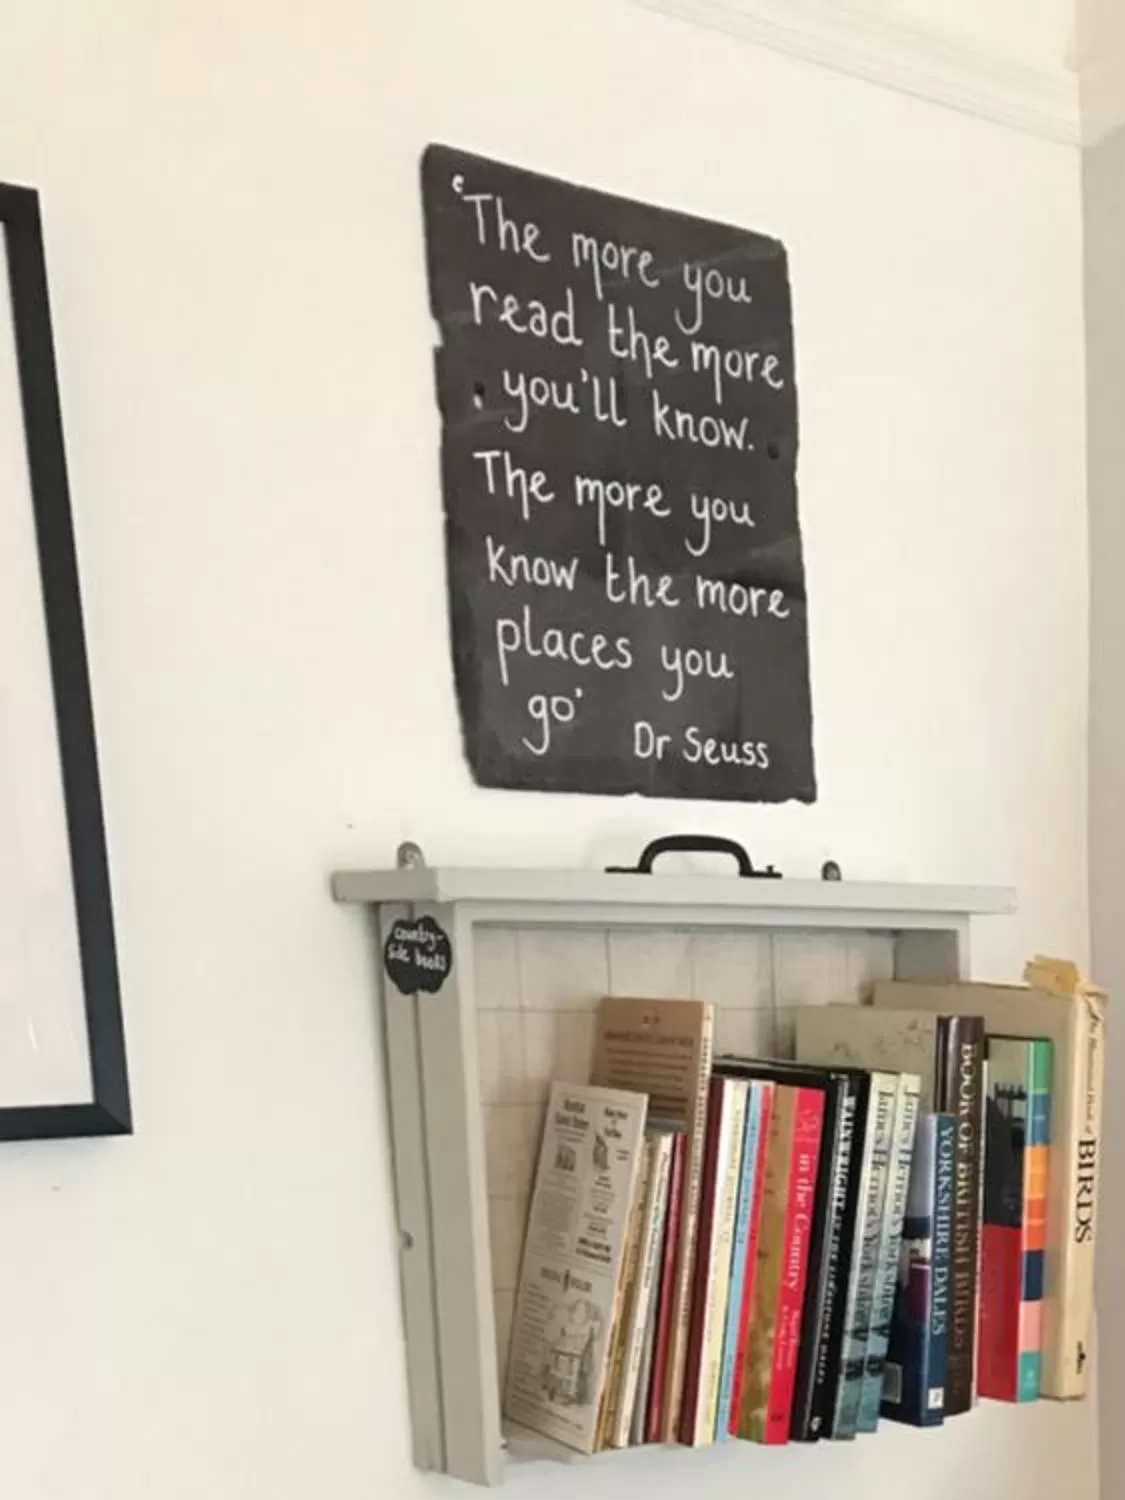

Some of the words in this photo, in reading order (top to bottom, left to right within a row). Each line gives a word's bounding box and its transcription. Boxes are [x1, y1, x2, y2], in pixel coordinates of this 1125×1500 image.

[572, 232, 659, 300] more
[674, 262, 751, 334] you
[469, 282, 582, 346] read
[608, 303, 678, 378] the
[690, 342, 784, 405] more
[503, 368, 627, 433] you'll
[653, 390, 754, 450] know.
[473, 451, 555, 520] The
[575, 475, 671, 546] more
[685, 493, 755, 556] you
[605, 552, 680, 608] the
[696, 576, 791, 619] more
[497, 604, 633, 688] places
[661, 645, 735, 702] you
[633, 721, 672, 760] Dr
[682, 727, 769, 769] Seuss
[956, 1122, 975, 1153] OF
[793, 1181, 815, 1208] the
[933, 1126, 954, 1261] YORKSHIRE
[1072, 1138, 1097, 1243] BIRDS
[782, 1213, 811, 1292] Country
[930, 1266, 949, 1335] DALES
